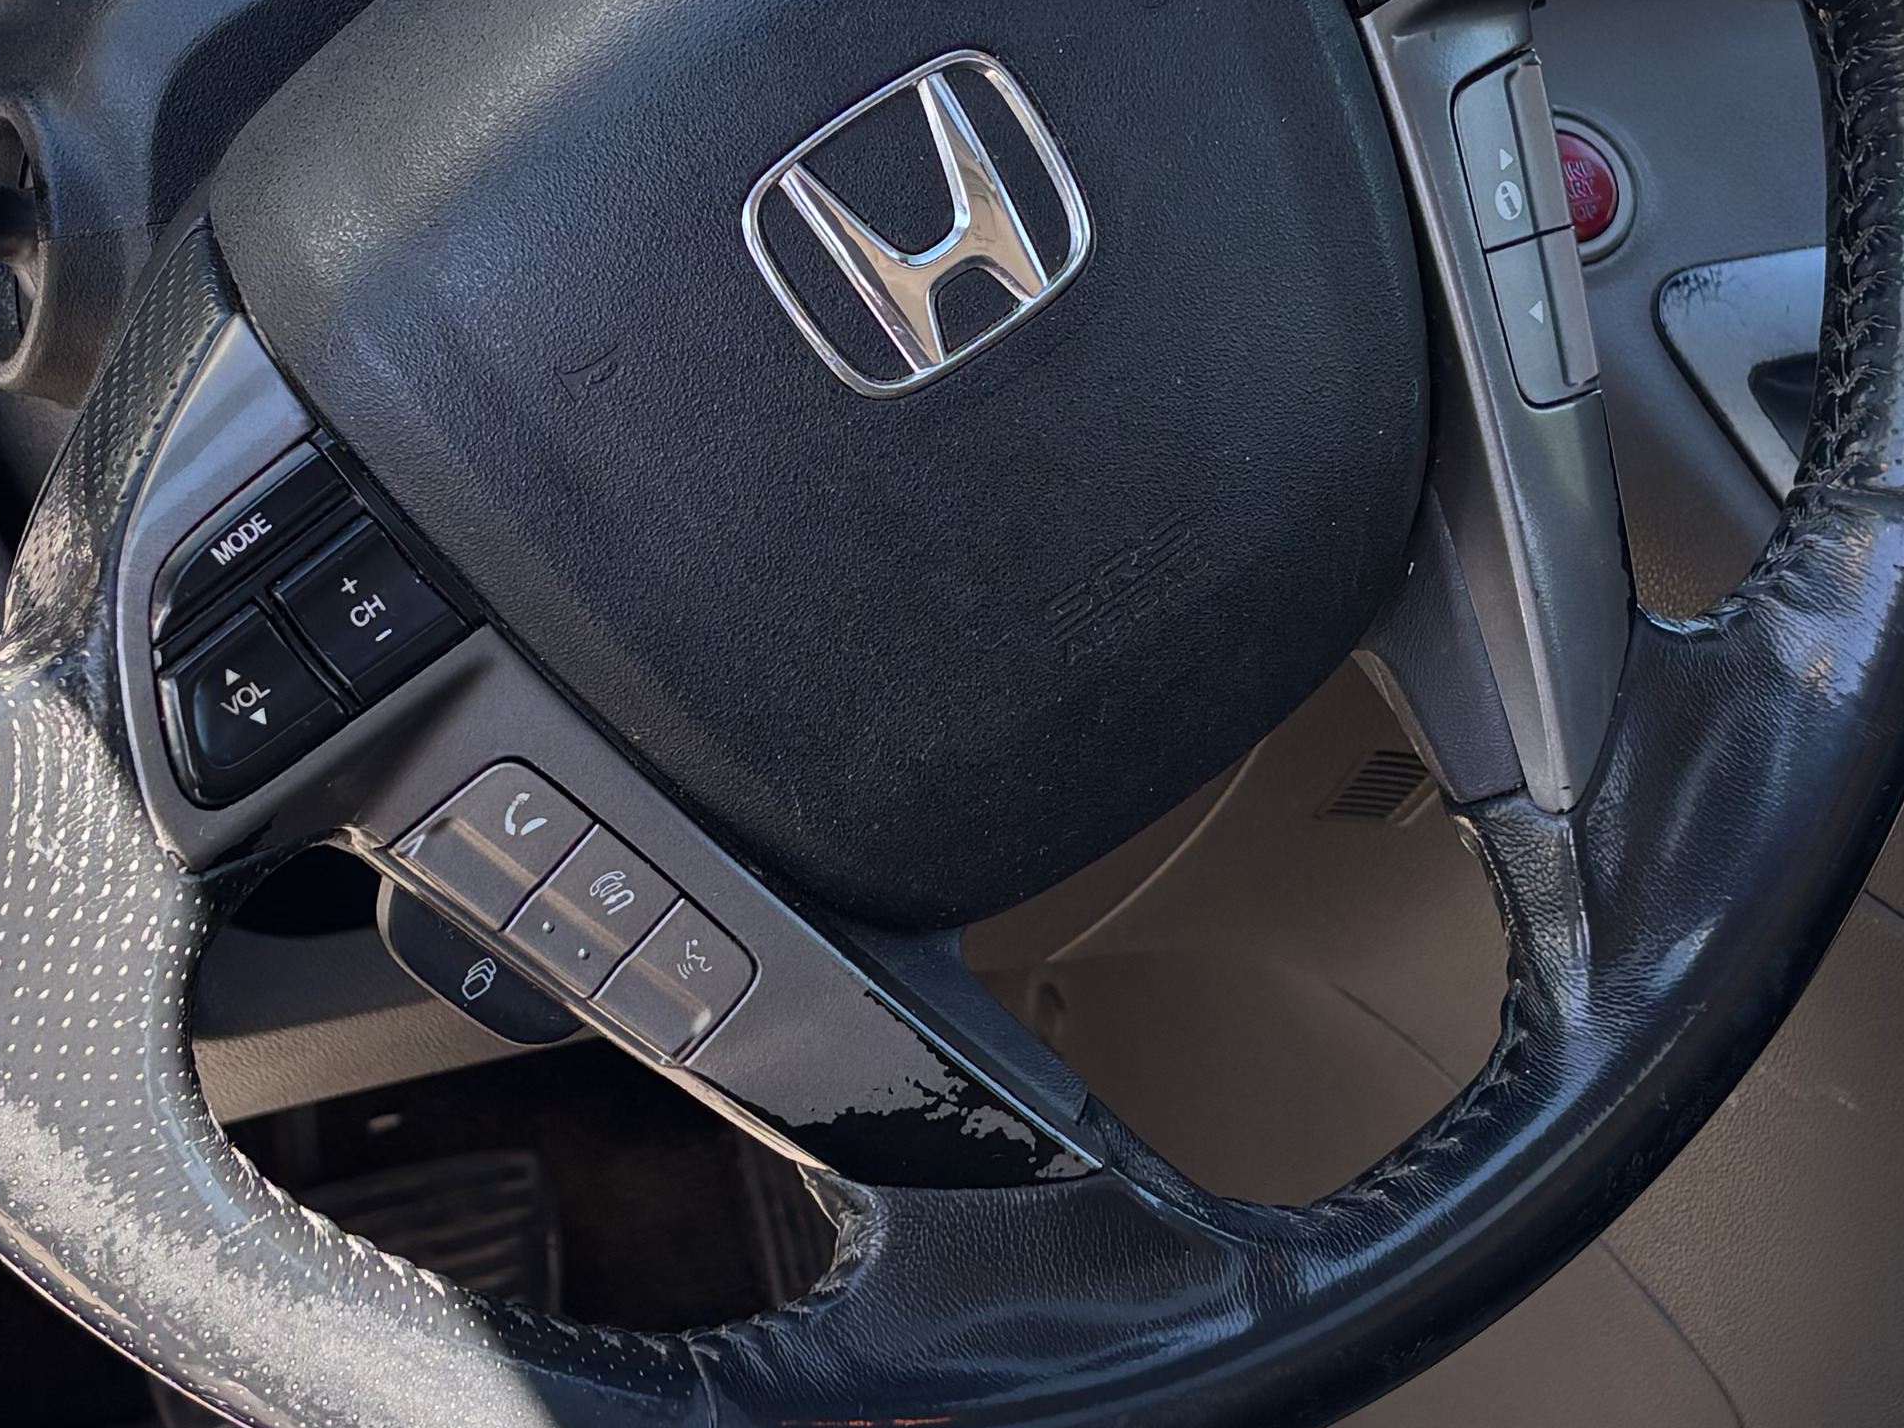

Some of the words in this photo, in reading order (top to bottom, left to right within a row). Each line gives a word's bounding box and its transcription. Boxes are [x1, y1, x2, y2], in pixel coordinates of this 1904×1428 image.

[211, 511, 273, 566] MODE
[349, 595, 387, 629] CH
[221, 678, 270, 716] VOL
